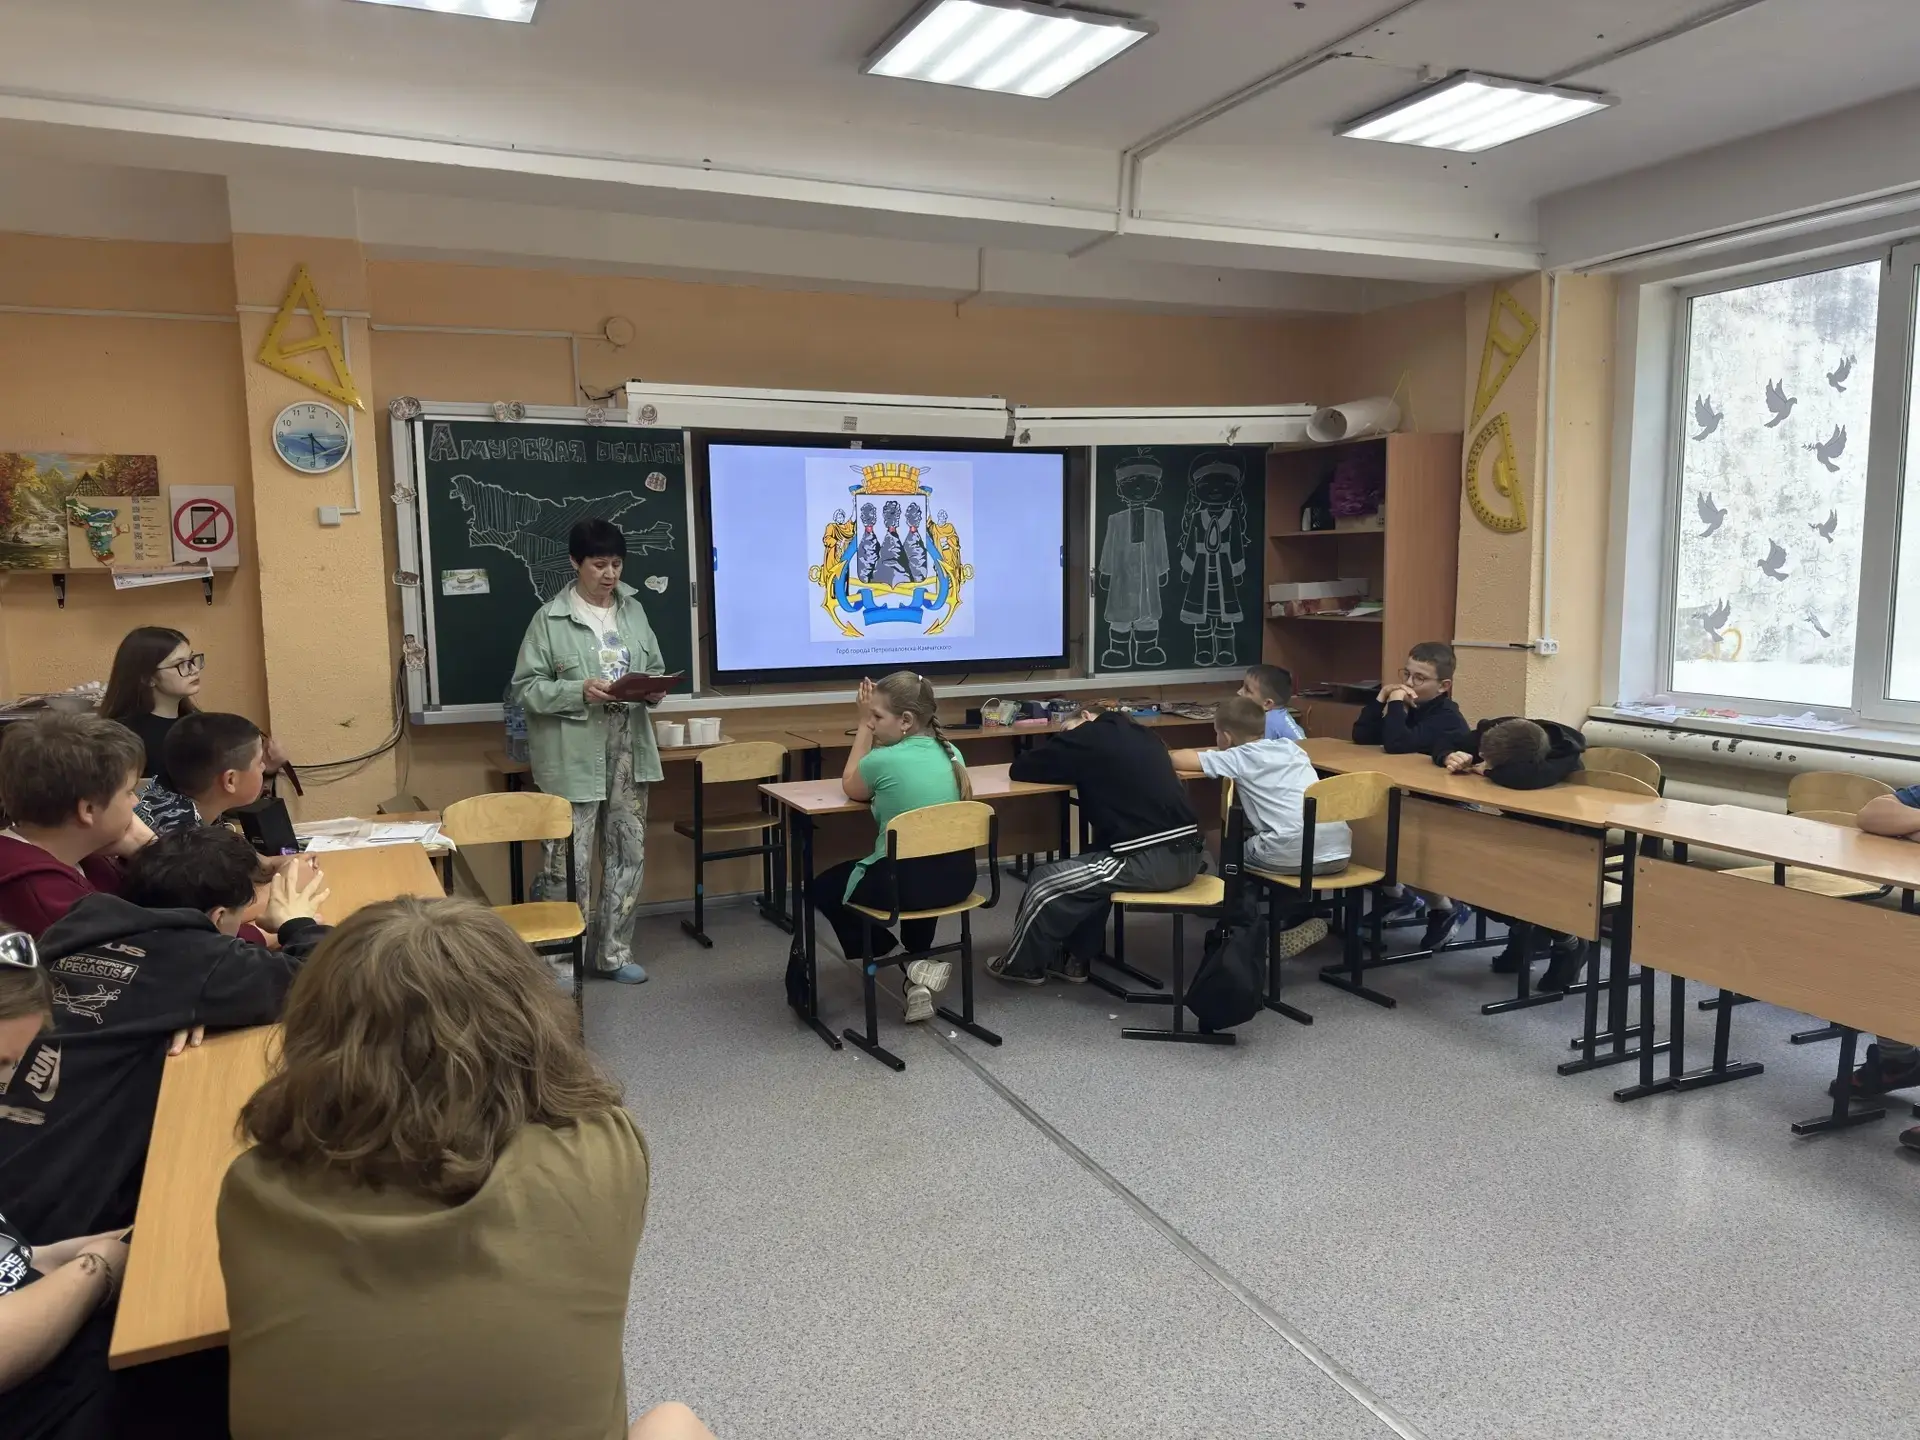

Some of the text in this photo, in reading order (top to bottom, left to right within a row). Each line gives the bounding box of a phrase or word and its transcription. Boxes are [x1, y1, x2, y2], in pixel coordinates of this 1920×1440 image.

[283, 419, 291, 427] 10
[85, 957, 97, 965] OF
[65, 961, 121, 979] PEGASUS
[25, 1043, 58, 1090] RUN
